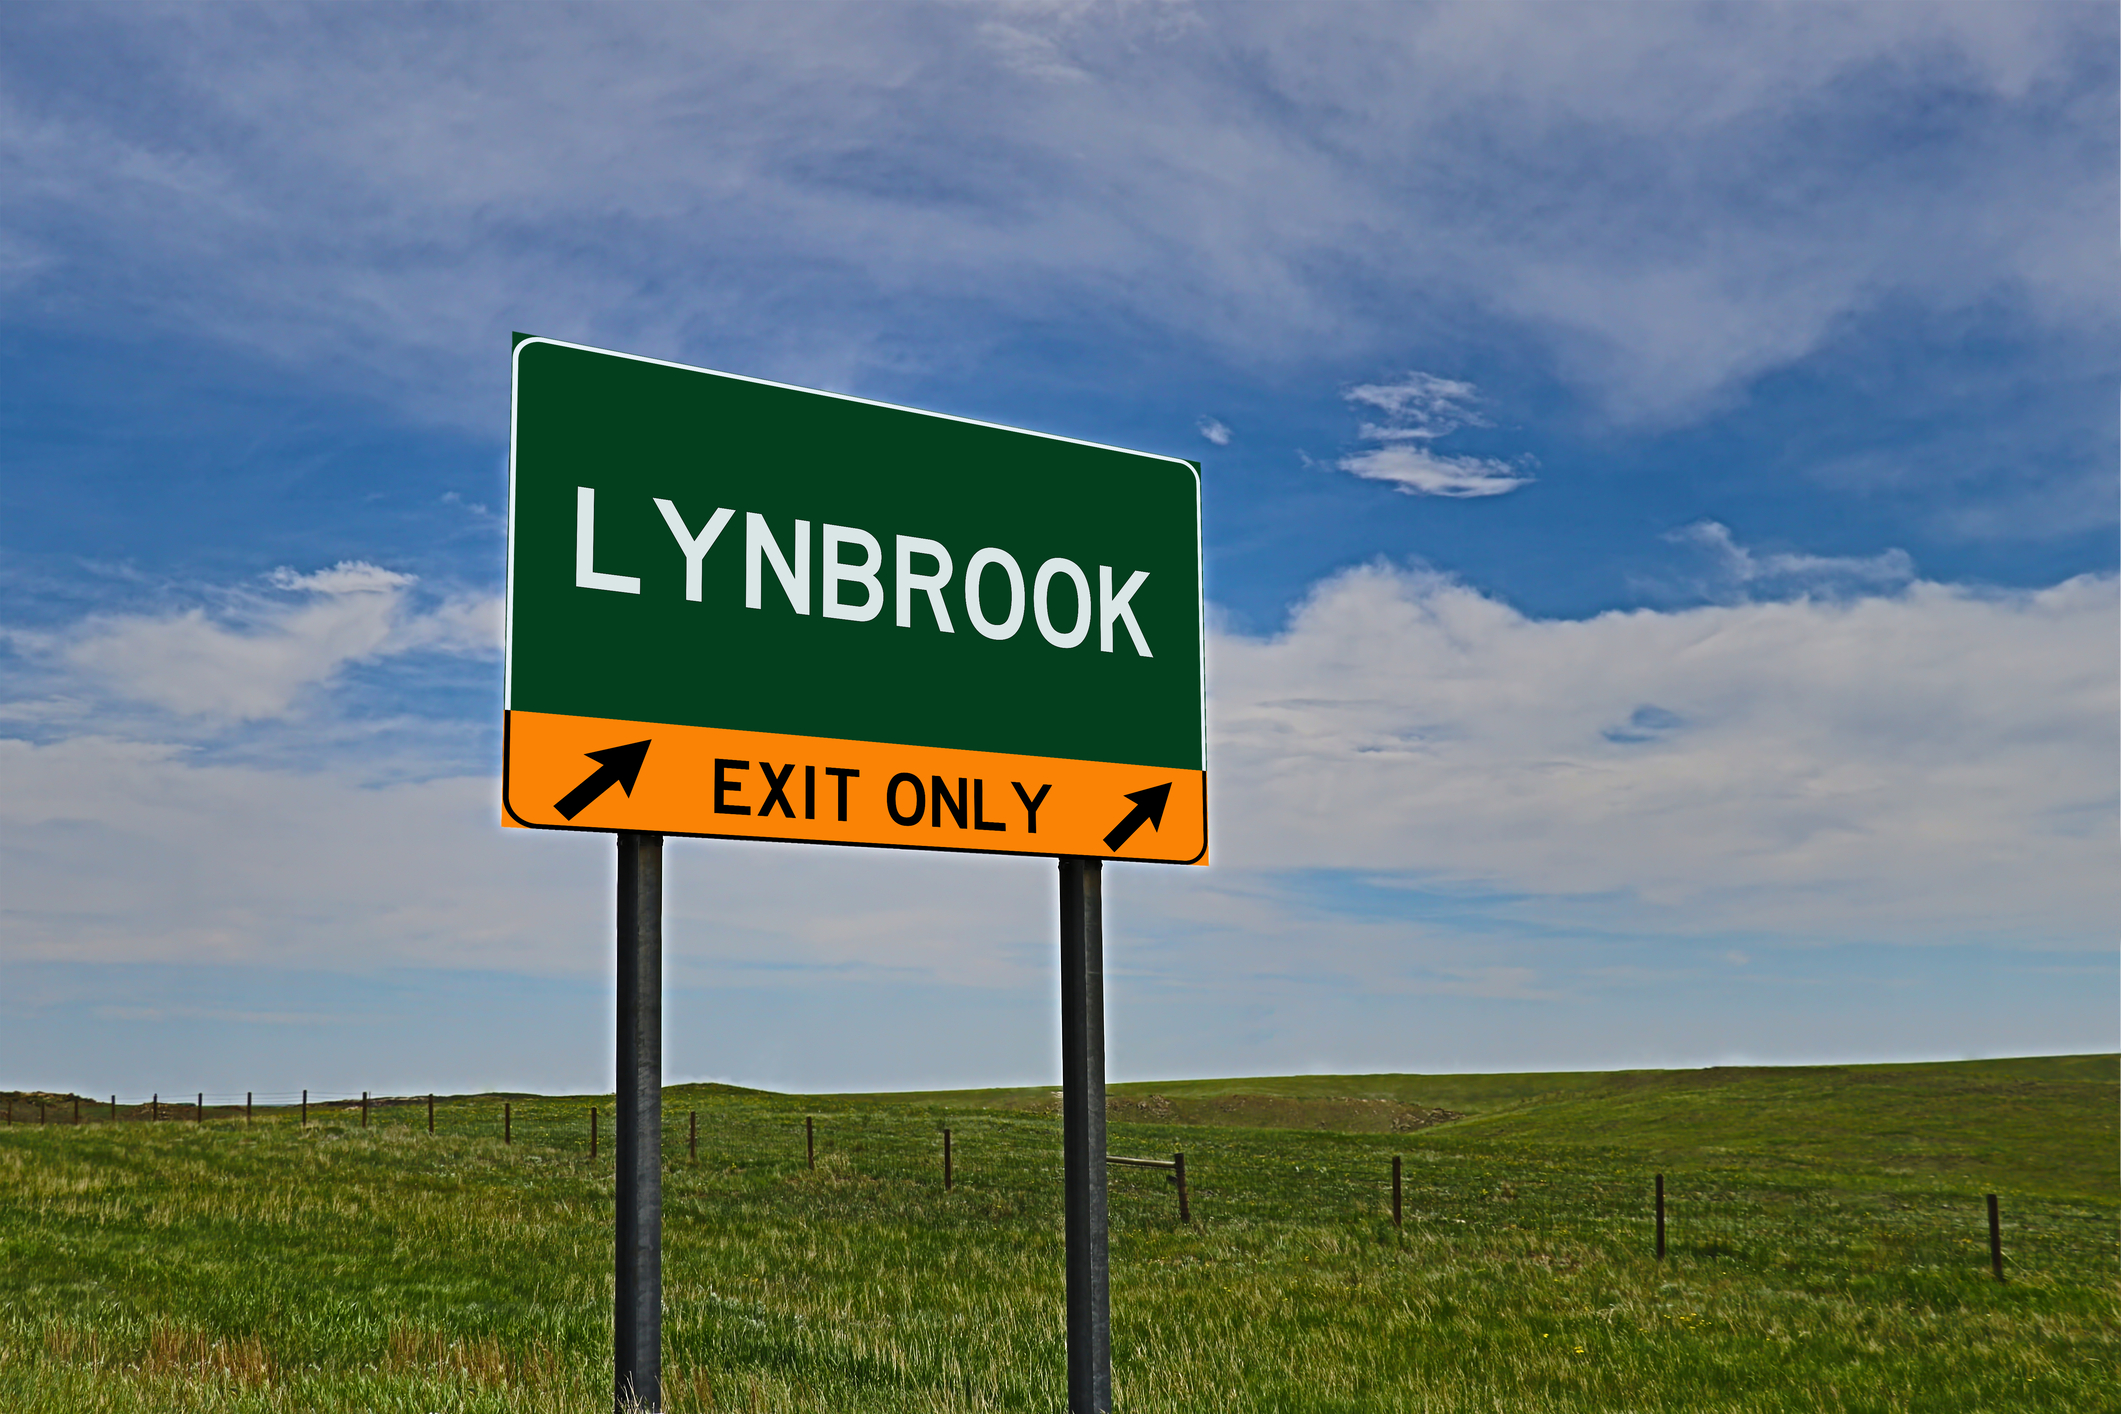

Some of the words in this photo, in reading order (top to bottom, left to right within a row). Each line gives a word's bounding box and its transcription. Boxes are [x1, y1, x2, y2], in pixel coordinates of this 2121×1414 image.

[575, 486, 1154, 658] LYNBROOK
[713, 758, 860, 822] EXIT
[886, 772, 1053, 834] ONLY
